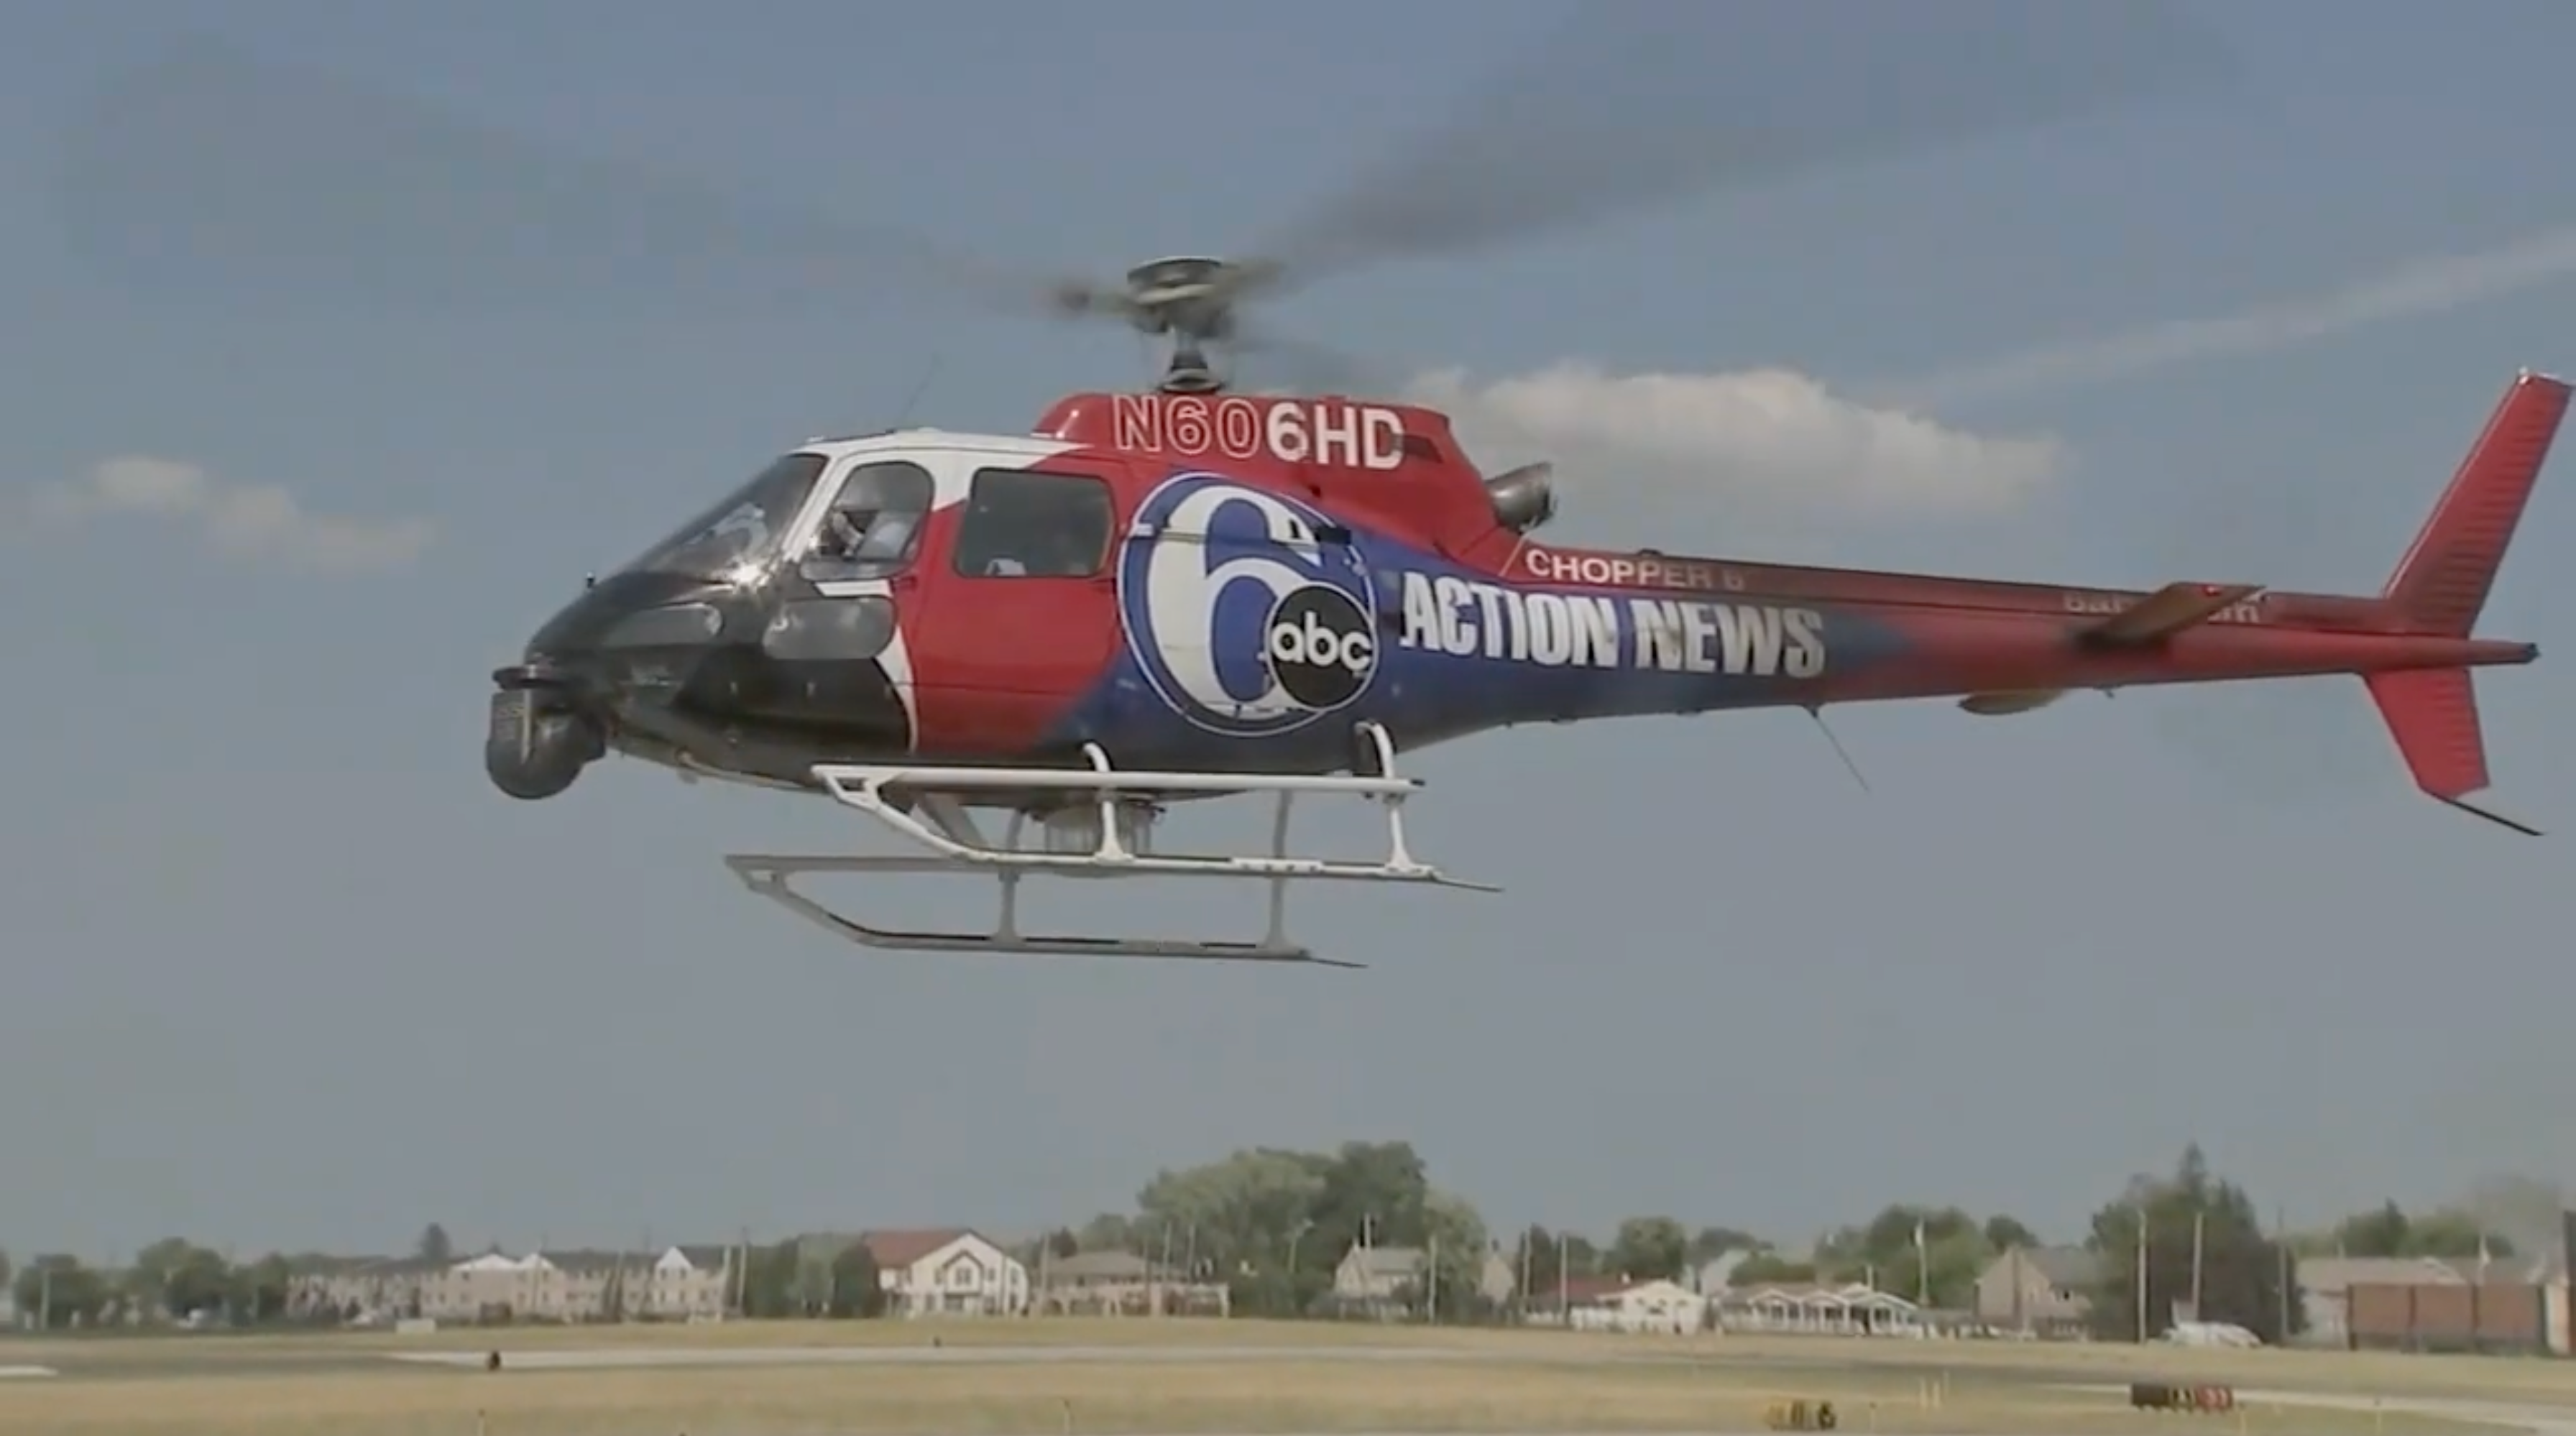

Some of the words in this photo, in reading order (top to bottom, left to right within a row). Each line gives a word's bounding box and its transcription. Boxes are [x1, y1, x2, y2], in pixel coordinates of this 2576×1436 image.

[1112, 395, 1404, 470] N606HD
[1148, 484, 1322, 720] 6
[1525, 548, 1712, 589] CHOPPER
[1270, 611, 1373, 671] abc
[1399, 571, 1619, 669] ACTION
[1627, 599, 1826, 678] NEWS
